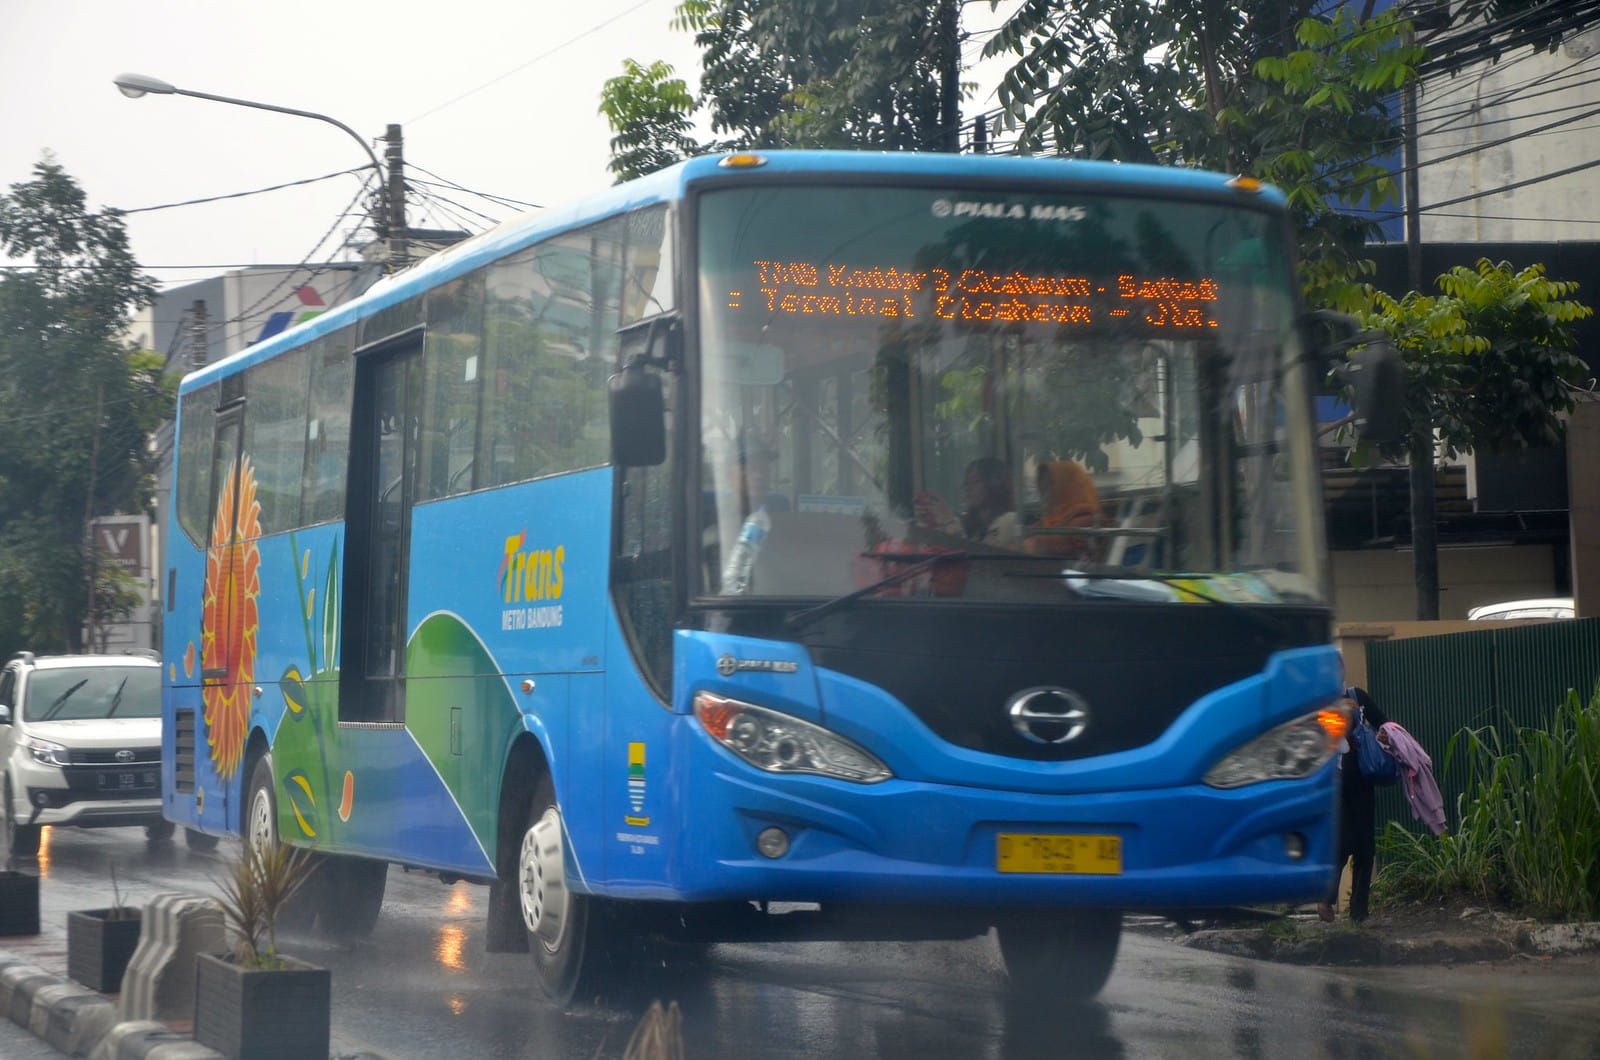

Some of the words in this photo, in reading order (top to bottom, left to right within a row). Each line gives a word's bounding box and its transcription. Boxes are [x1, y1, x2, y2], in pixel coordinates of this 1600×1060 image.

[1030, 205, 1086, 221] MAS
[760, 287, 915, 318] Terminal
[499, 531, 565, 603] Trans
